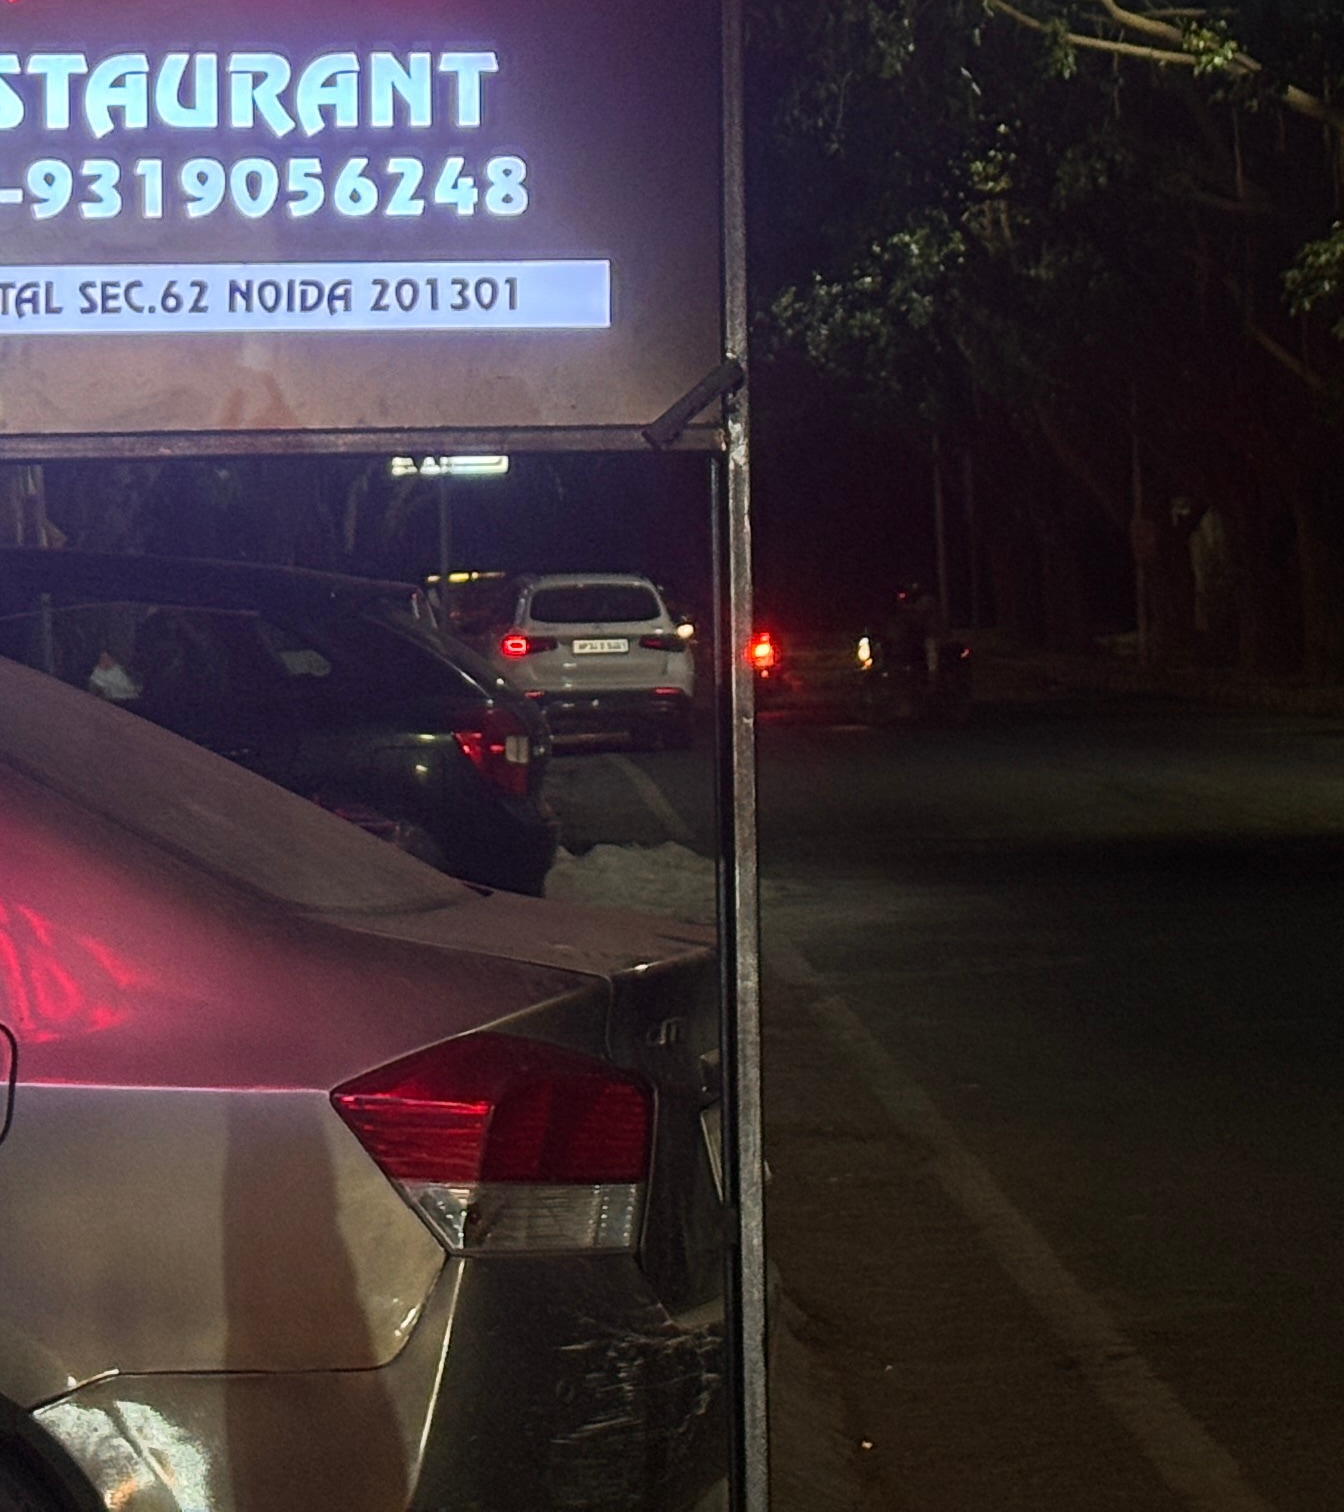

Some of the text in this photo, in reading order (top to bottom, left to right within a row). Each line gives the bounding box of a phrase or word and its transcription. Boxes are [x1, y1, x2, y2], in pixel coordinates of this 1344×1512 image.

[79, 279, 209, 316] SEC.62
[228, 278, 352, 316] NOIDA
[370, 277, 519, 312] 201301
